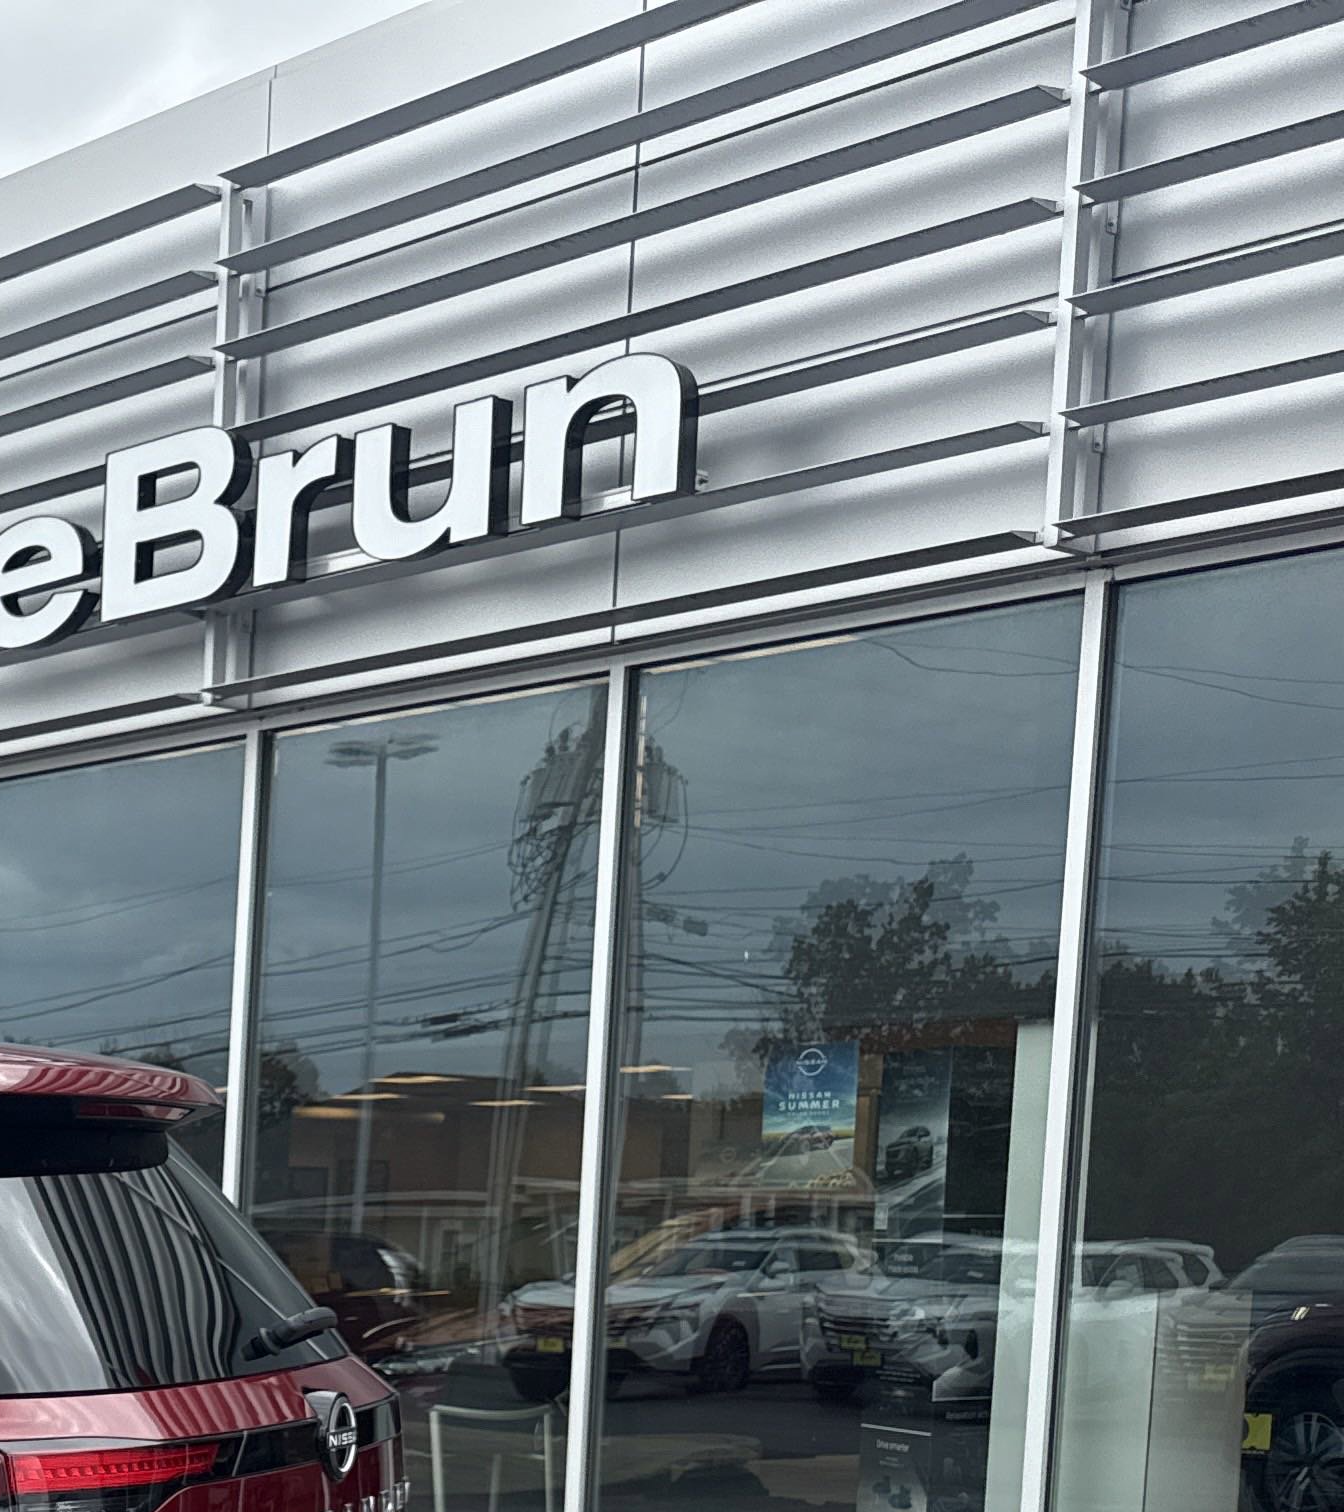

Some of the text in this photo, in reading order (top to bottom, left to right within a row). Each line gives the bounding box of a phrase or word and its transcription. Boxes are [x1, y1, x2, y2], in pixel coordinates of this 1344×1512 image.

[788, 1091, 831, 1100] NISSAN
[778, 1099, 840, 1111] SUMMER
[328, 1430, 357, 1448] NISS
